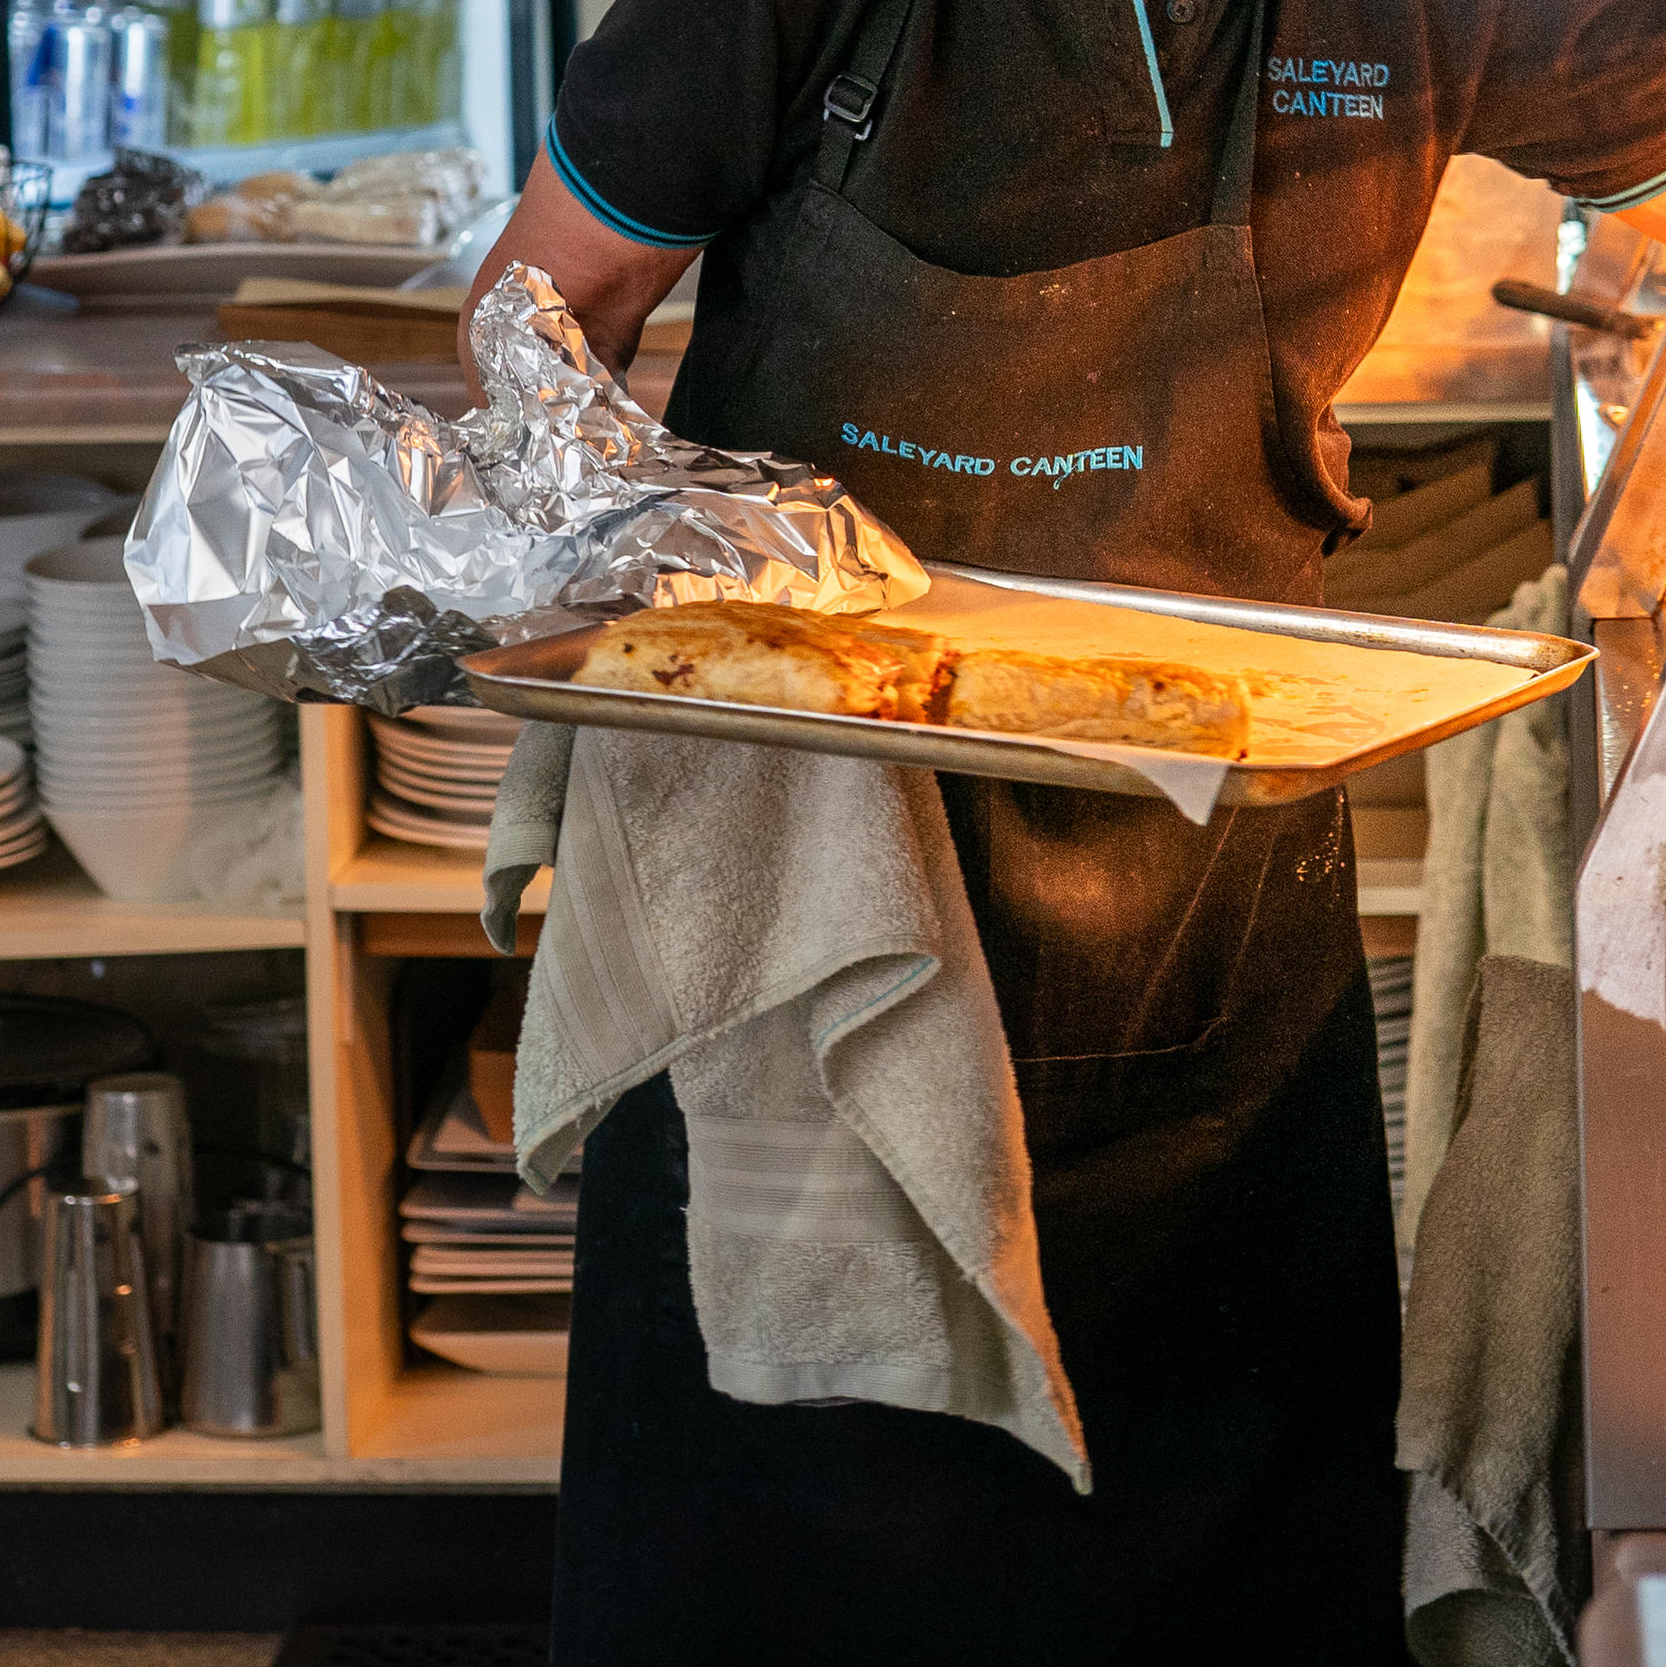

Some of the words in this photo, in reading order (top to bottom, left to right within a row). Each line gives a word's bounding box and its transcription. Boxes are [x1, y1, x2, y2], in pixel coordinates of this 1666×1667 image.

[1267, 55, 1391, 88] SALEYARD
[1272, 88, 1385, 121] CANTEEN
[840, 421, 996, 477] SALEYARD
[1009, 445, 1144, 480] CANTEEN
